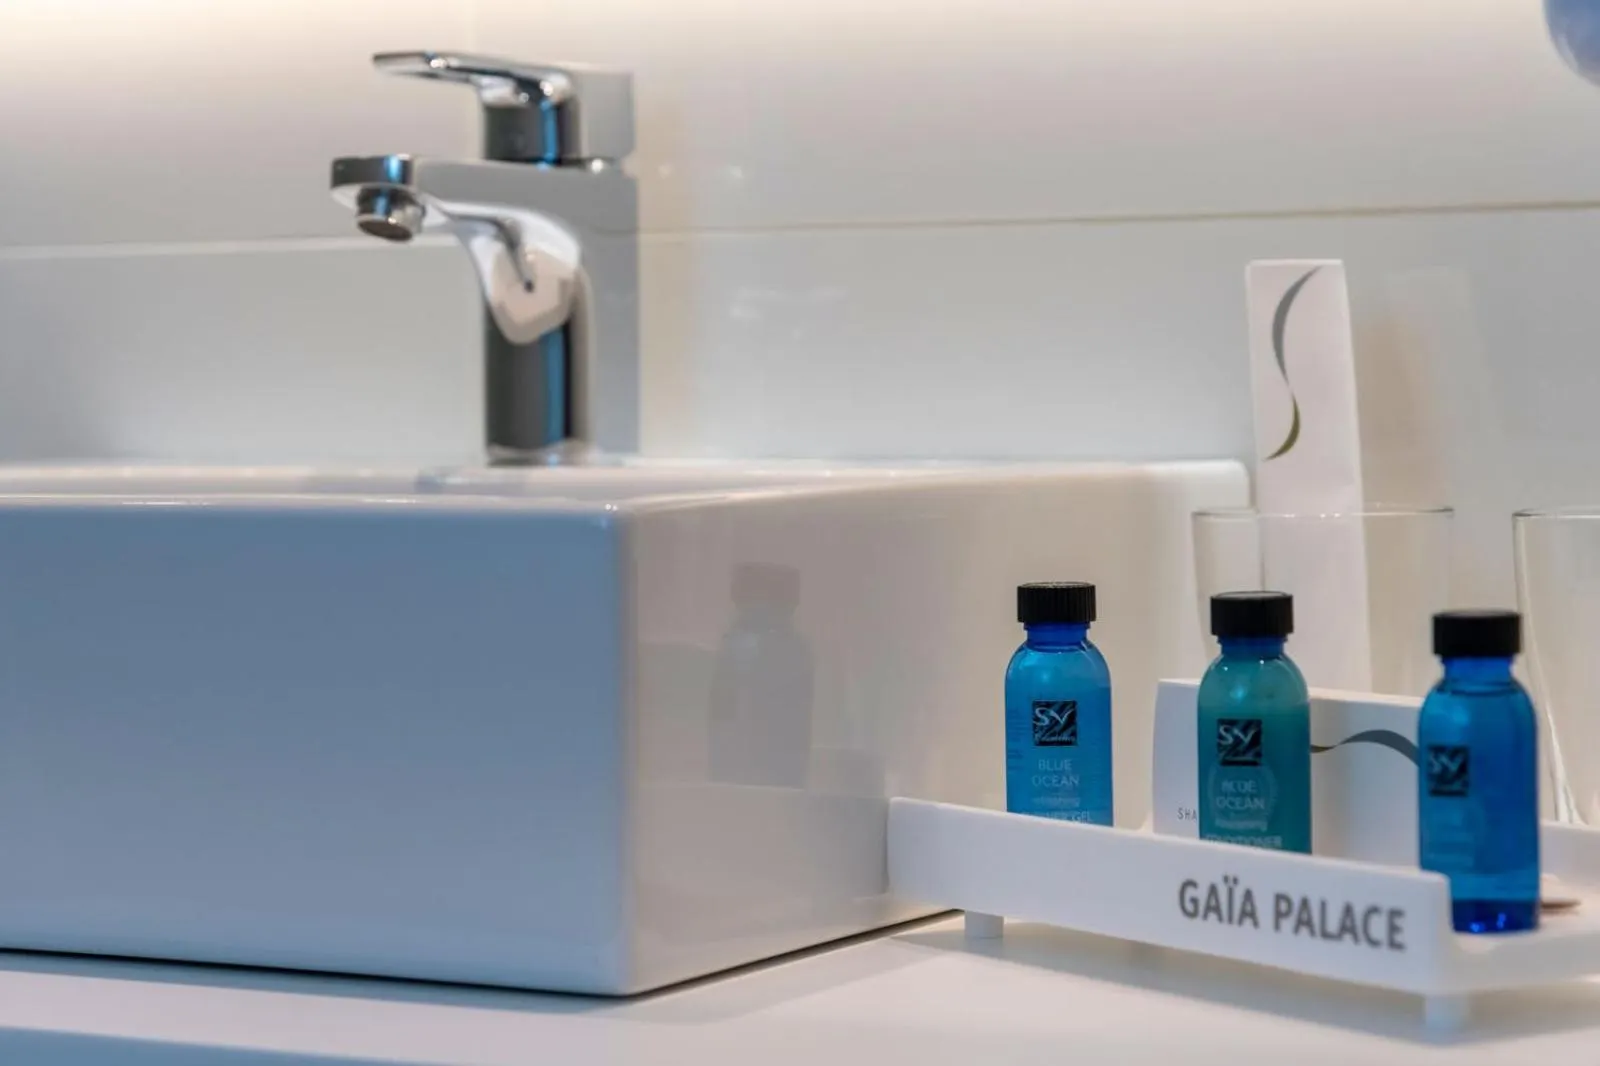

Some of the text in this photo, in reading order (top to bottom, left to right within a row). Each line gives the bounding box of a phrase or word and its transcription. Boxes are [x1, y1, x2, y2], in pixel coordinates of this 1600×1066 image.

[1038, 760, 1073, 771] BLUE
[1031, 774, 1080, 788] OCEAN
[1216, 796, 1265, 810] OCEAN
[1178, 874, 1407, 951] GAÏA PALACE
